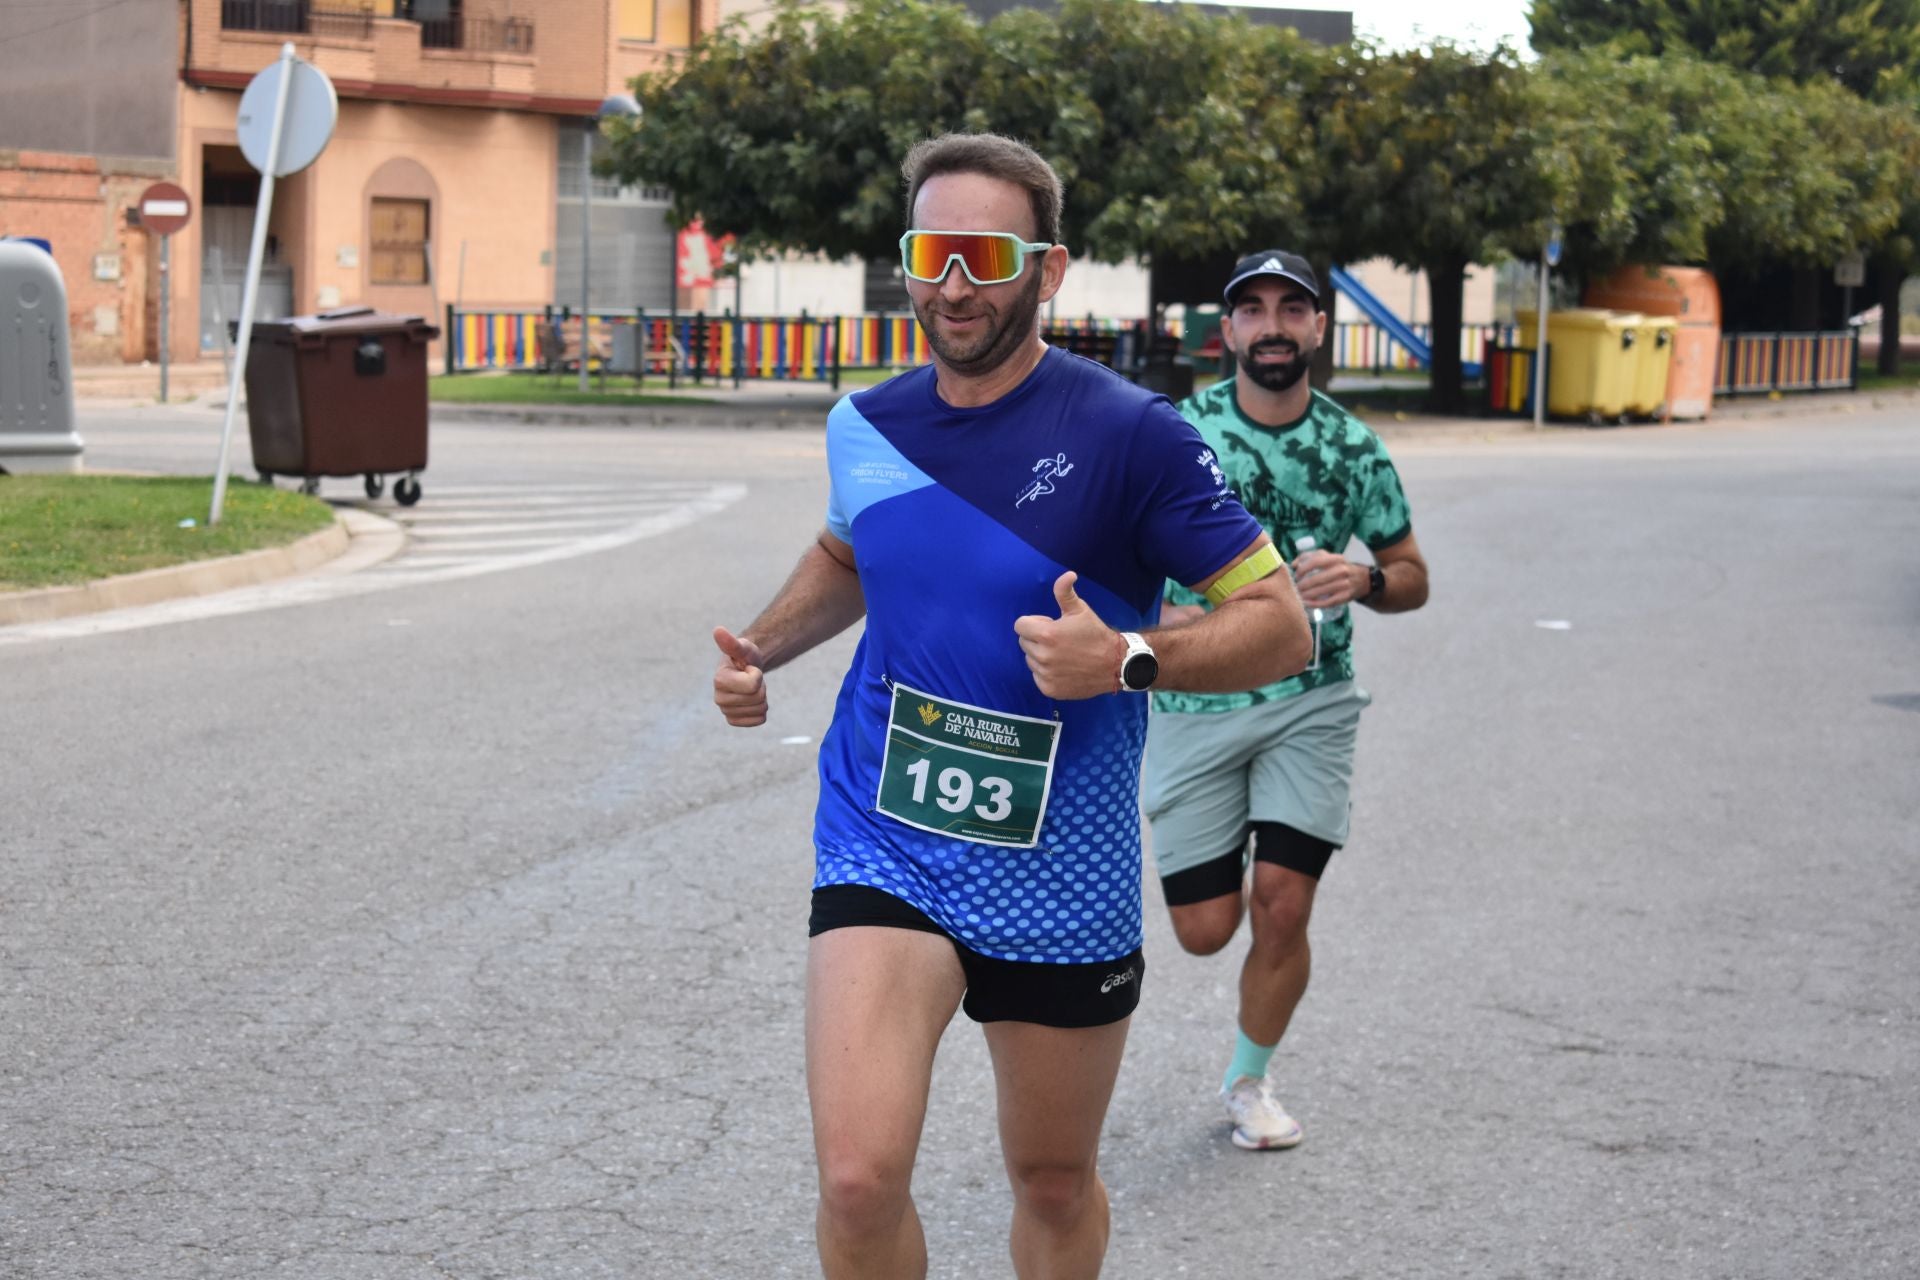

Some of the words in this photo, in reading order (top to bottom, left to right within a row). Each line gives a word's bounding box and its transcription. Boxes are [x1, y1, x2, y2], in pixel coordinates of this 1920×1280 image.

[875, 469, 909, 480] FLYERS
[944, 722, 961, 735] DE
[963, 727, 1021, 747] NAVARRA
[946, 712, 975, 728] CAJA
[977, 719, 1018, 736] RURAL
[906, 758, 1013, 822] 193
